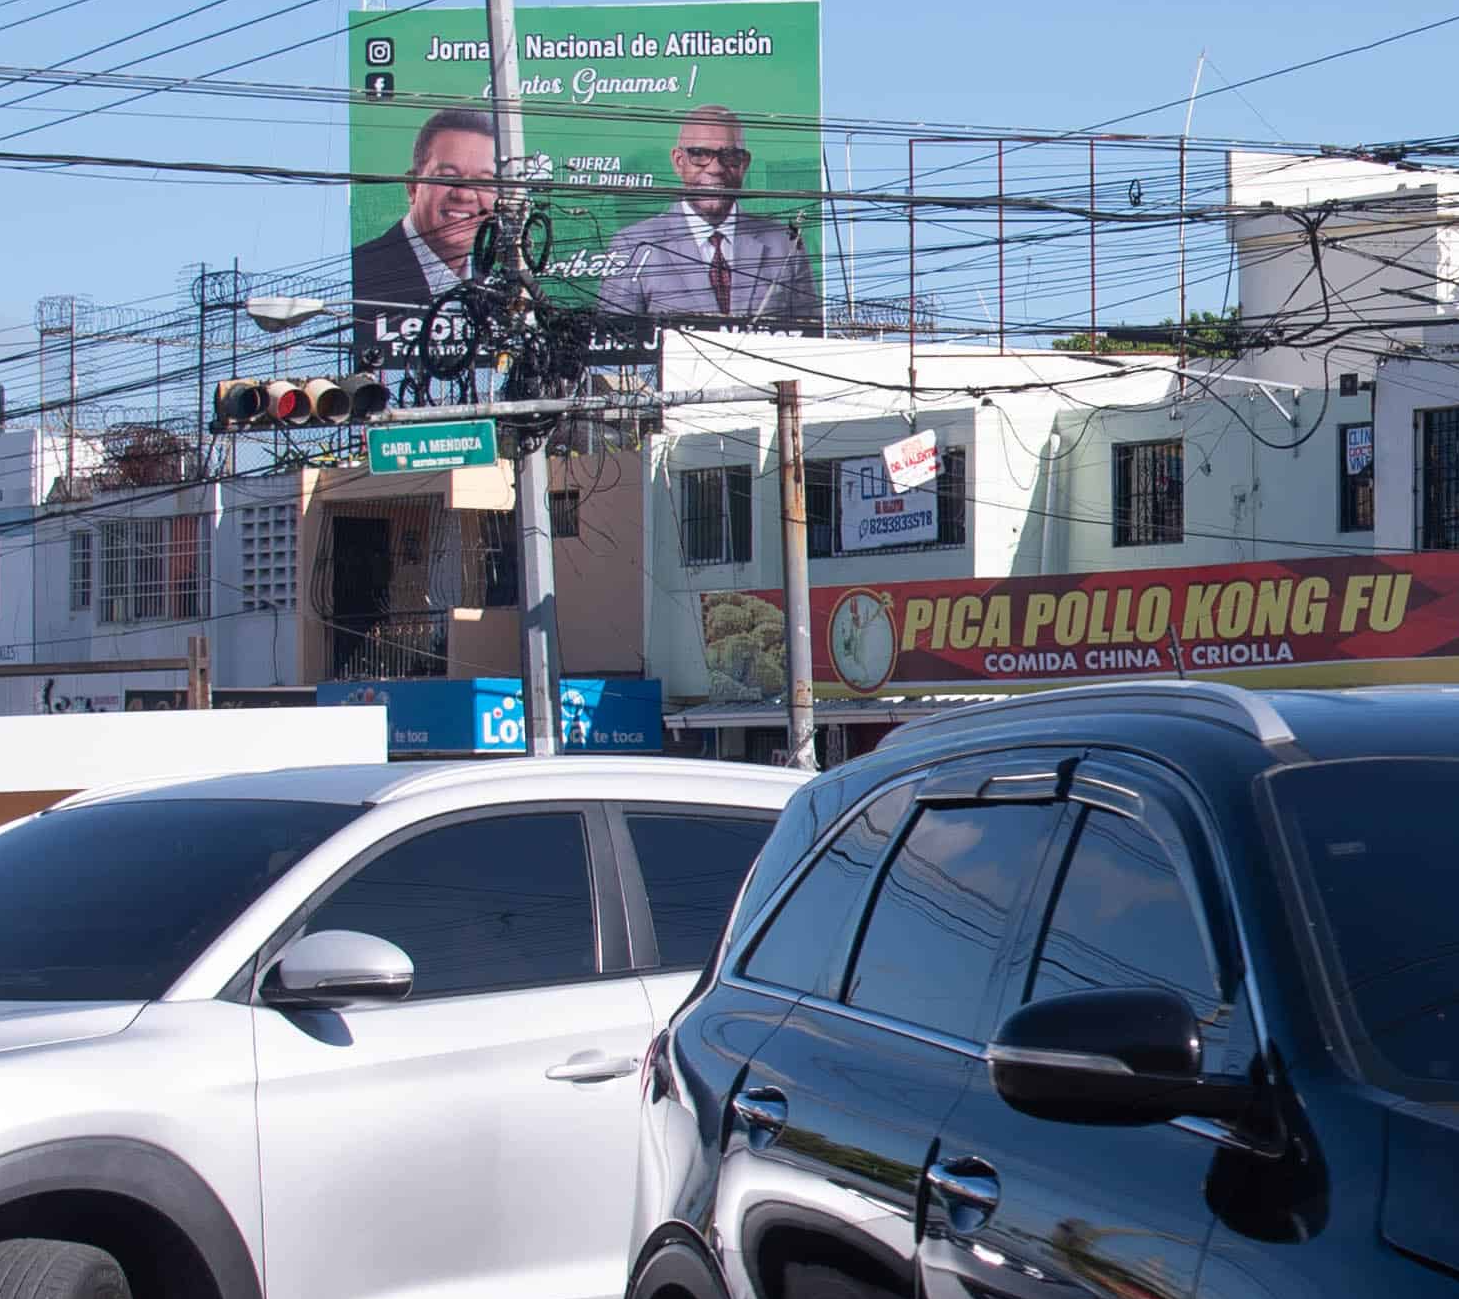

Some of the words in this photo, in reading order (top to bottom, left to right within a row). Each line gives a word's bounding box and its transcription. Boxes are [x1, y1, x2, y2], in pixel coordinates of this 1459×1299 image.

[526, 34, 624, 59] Nacional
[631, 34, 657, 57] de
[665, 27, 772, 57] Afiliación
[572, 68, 679, 104] Ganamos
[568, 156, 621, 172] FUERZA
[382, 441, 416, 457] CARR.
[419, 442, 428, 454] A
[429, 436, 482, 453] MENDOZA
[900, 594, 1011, 652] PICA
[1022, 585, 1173, 648] POLLO
[1181, 576, 1331, 640] KONG
[1339, 573, 1413, 633] FU
[984, 652, 1077, 674] COMIDA
[1085, 647, 1161, 670] CHINA
[1192, 641, 1294, 666] CRIOLLA
[594, 730, 609, 744] te
[612, 730, 643, 744] toca
